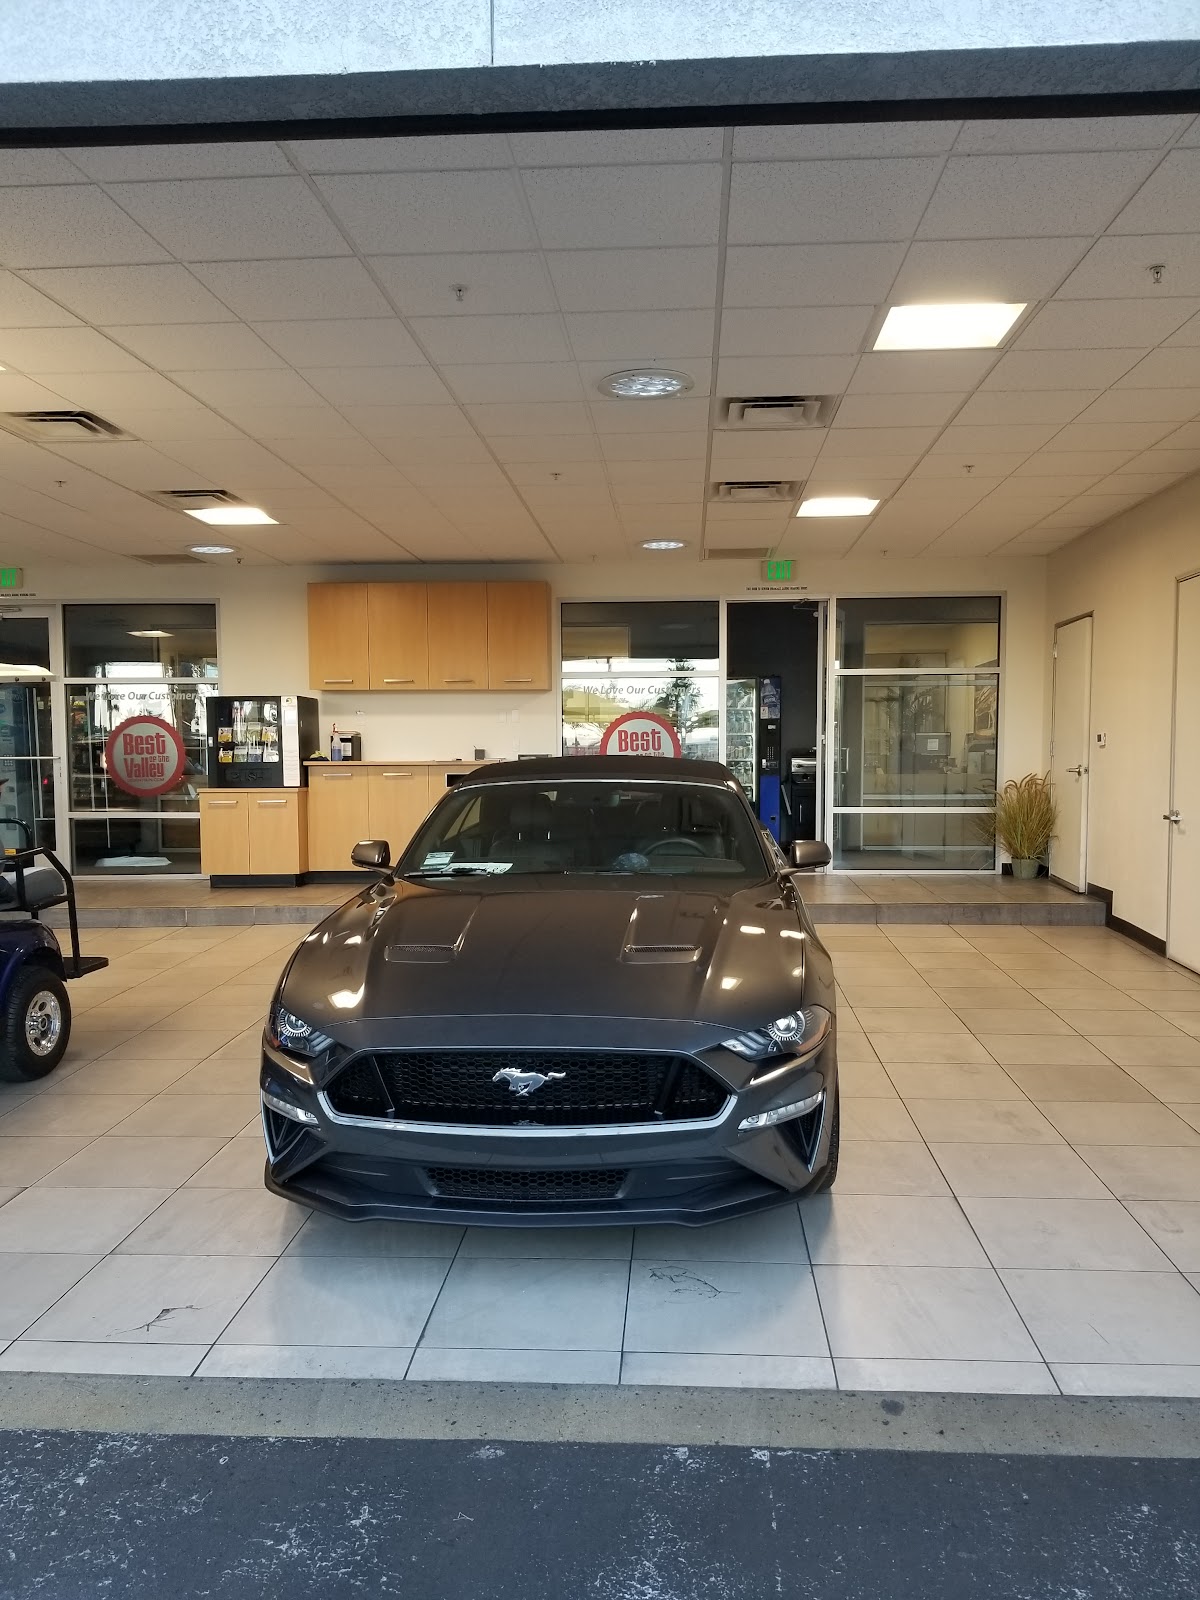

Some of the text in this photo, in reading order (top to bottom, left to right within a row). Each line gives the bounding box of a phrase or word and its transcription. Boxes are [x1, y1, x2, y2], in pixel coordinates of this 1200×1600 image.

[0, 569, 16, 586] XIT
[767, 561, 792, 580] EXIT
[127, 691, 148, 701] Our
[583, 685, 701, 695] We Love Our Customers
[122, 732, 166, 756] Best
[617, 728, 662, 752] Best
[122, 757, 165, 778] Valley
